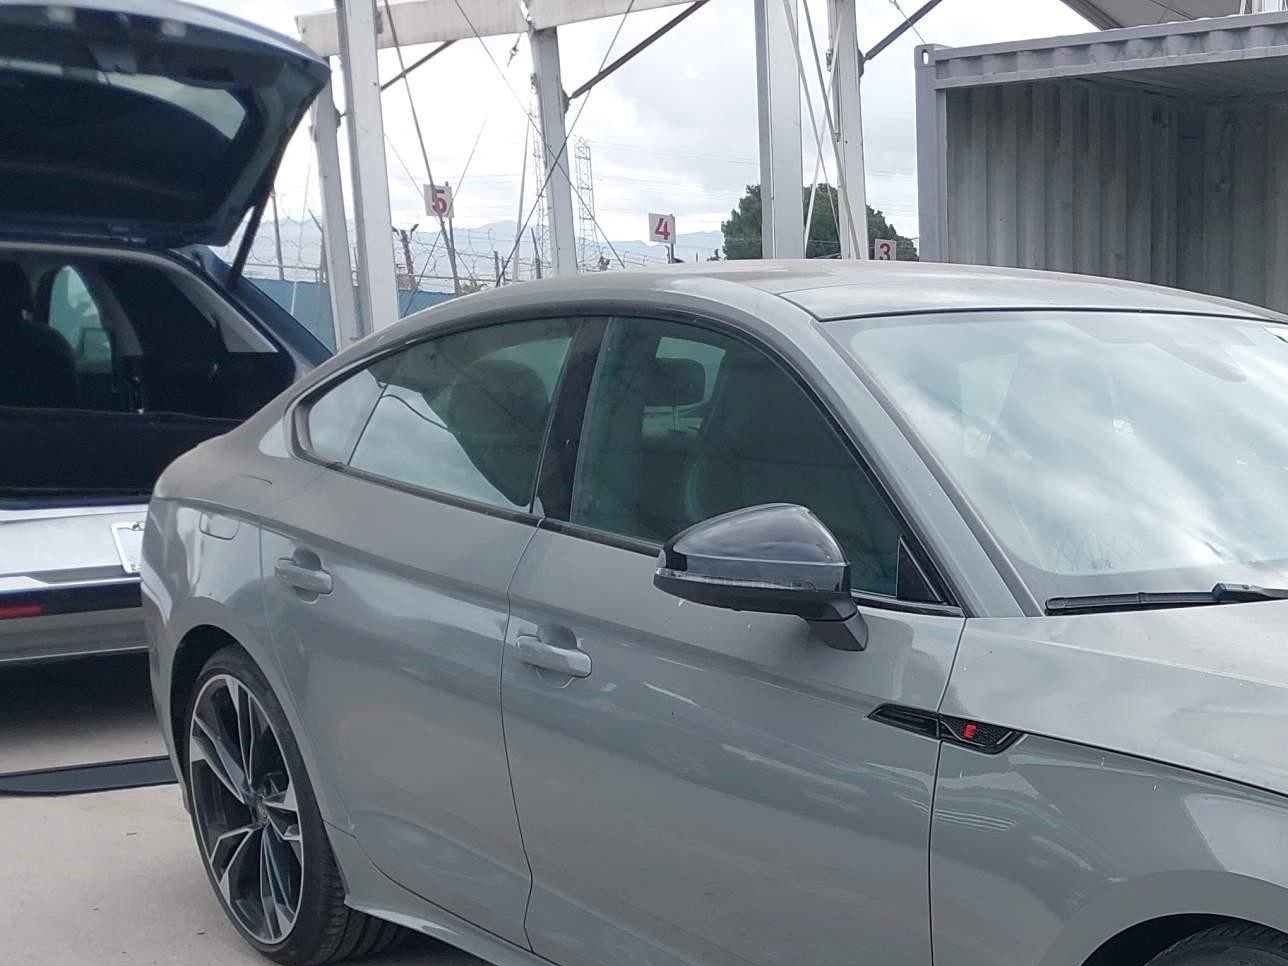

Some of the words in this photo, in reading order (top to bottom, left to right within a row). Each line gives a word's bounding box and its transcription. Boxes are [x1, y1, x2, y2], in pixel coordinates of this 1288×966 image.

[431, 188, 448, 215] 5
[654, 217, 671, 241] 4
[879, 242, 891, 261] 3
